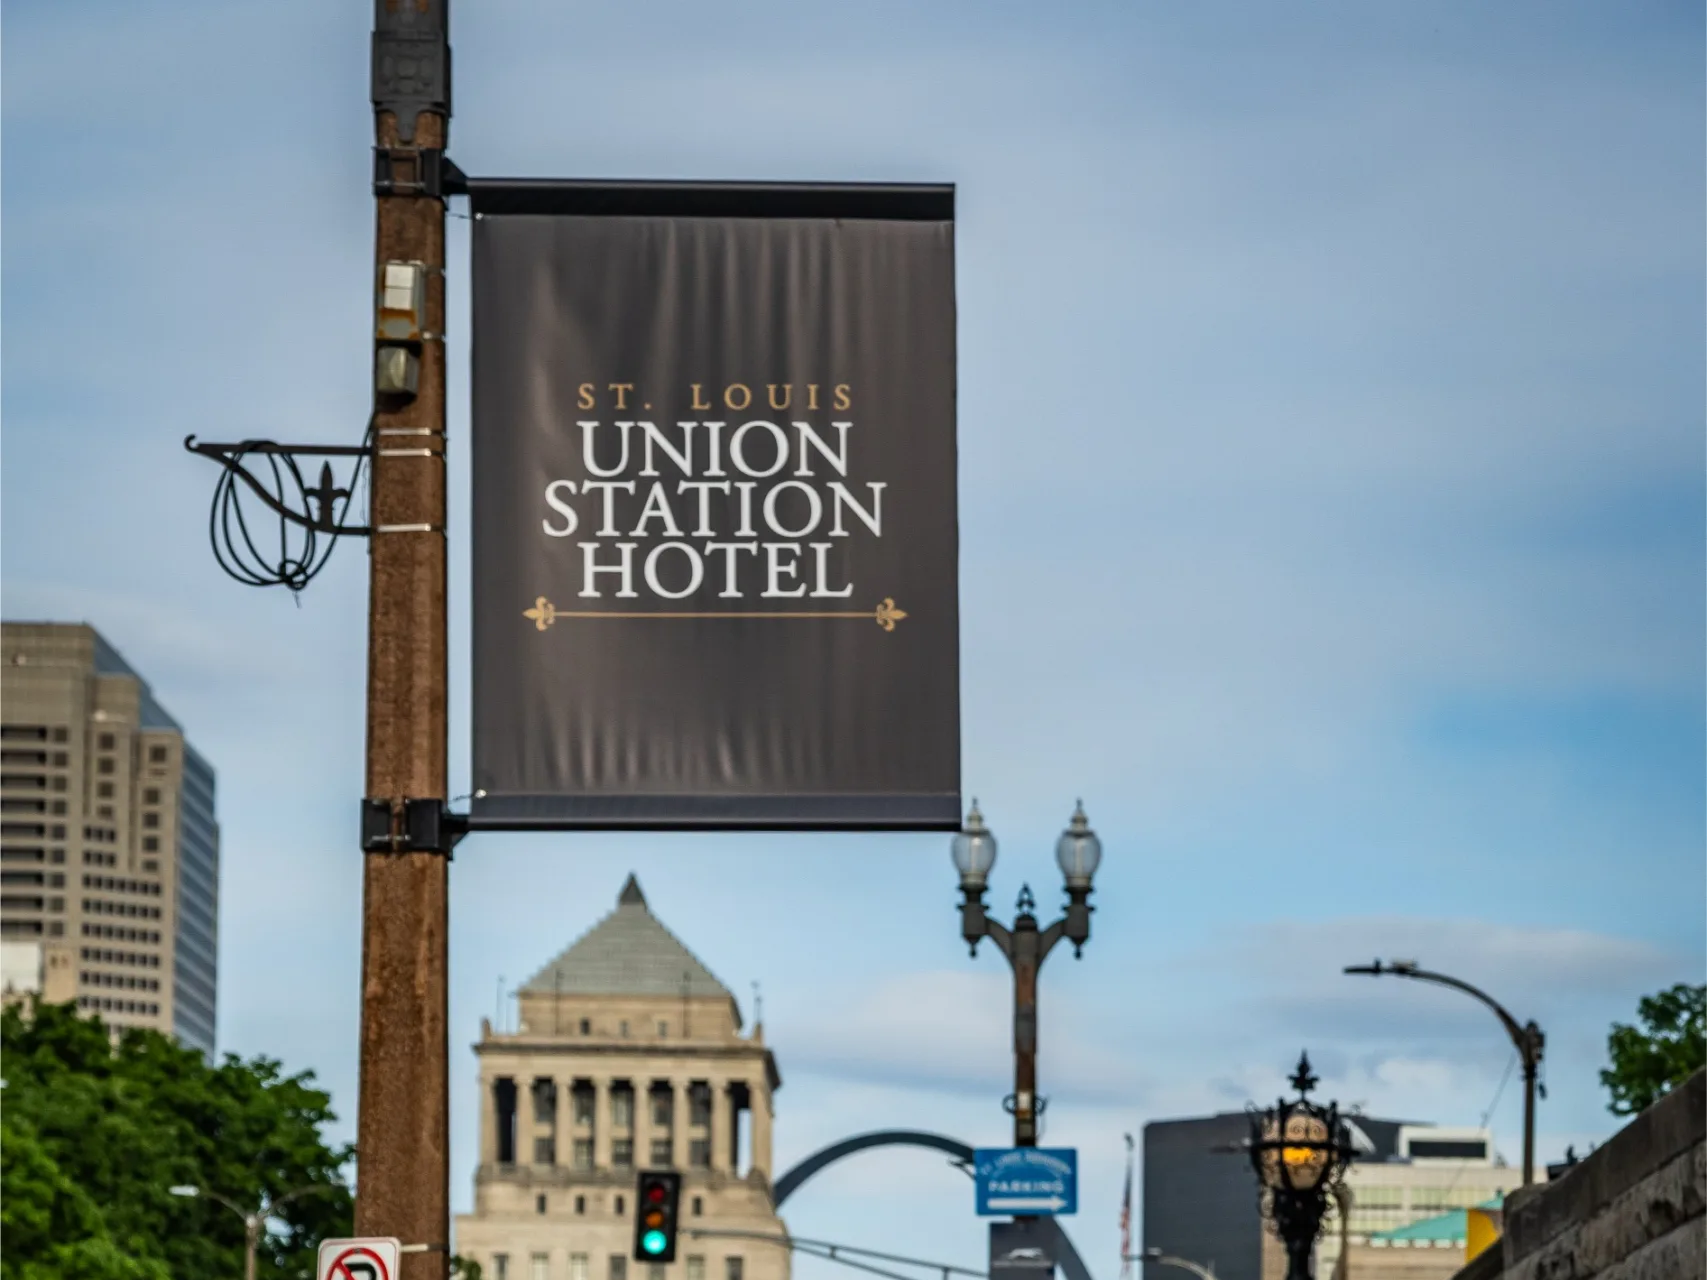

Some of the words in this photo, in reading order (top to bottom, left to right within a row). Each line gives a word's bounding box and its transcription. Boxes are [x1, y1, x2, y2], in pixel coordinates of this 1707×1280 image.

[577, 383, 652, 410] ST.
[690, 383, 852, 411] LOUIS
[576, 420, 854, 478] UNION
[542, 479, 888, 538] STATION
[577, 541, 854, 599] HOTEL
